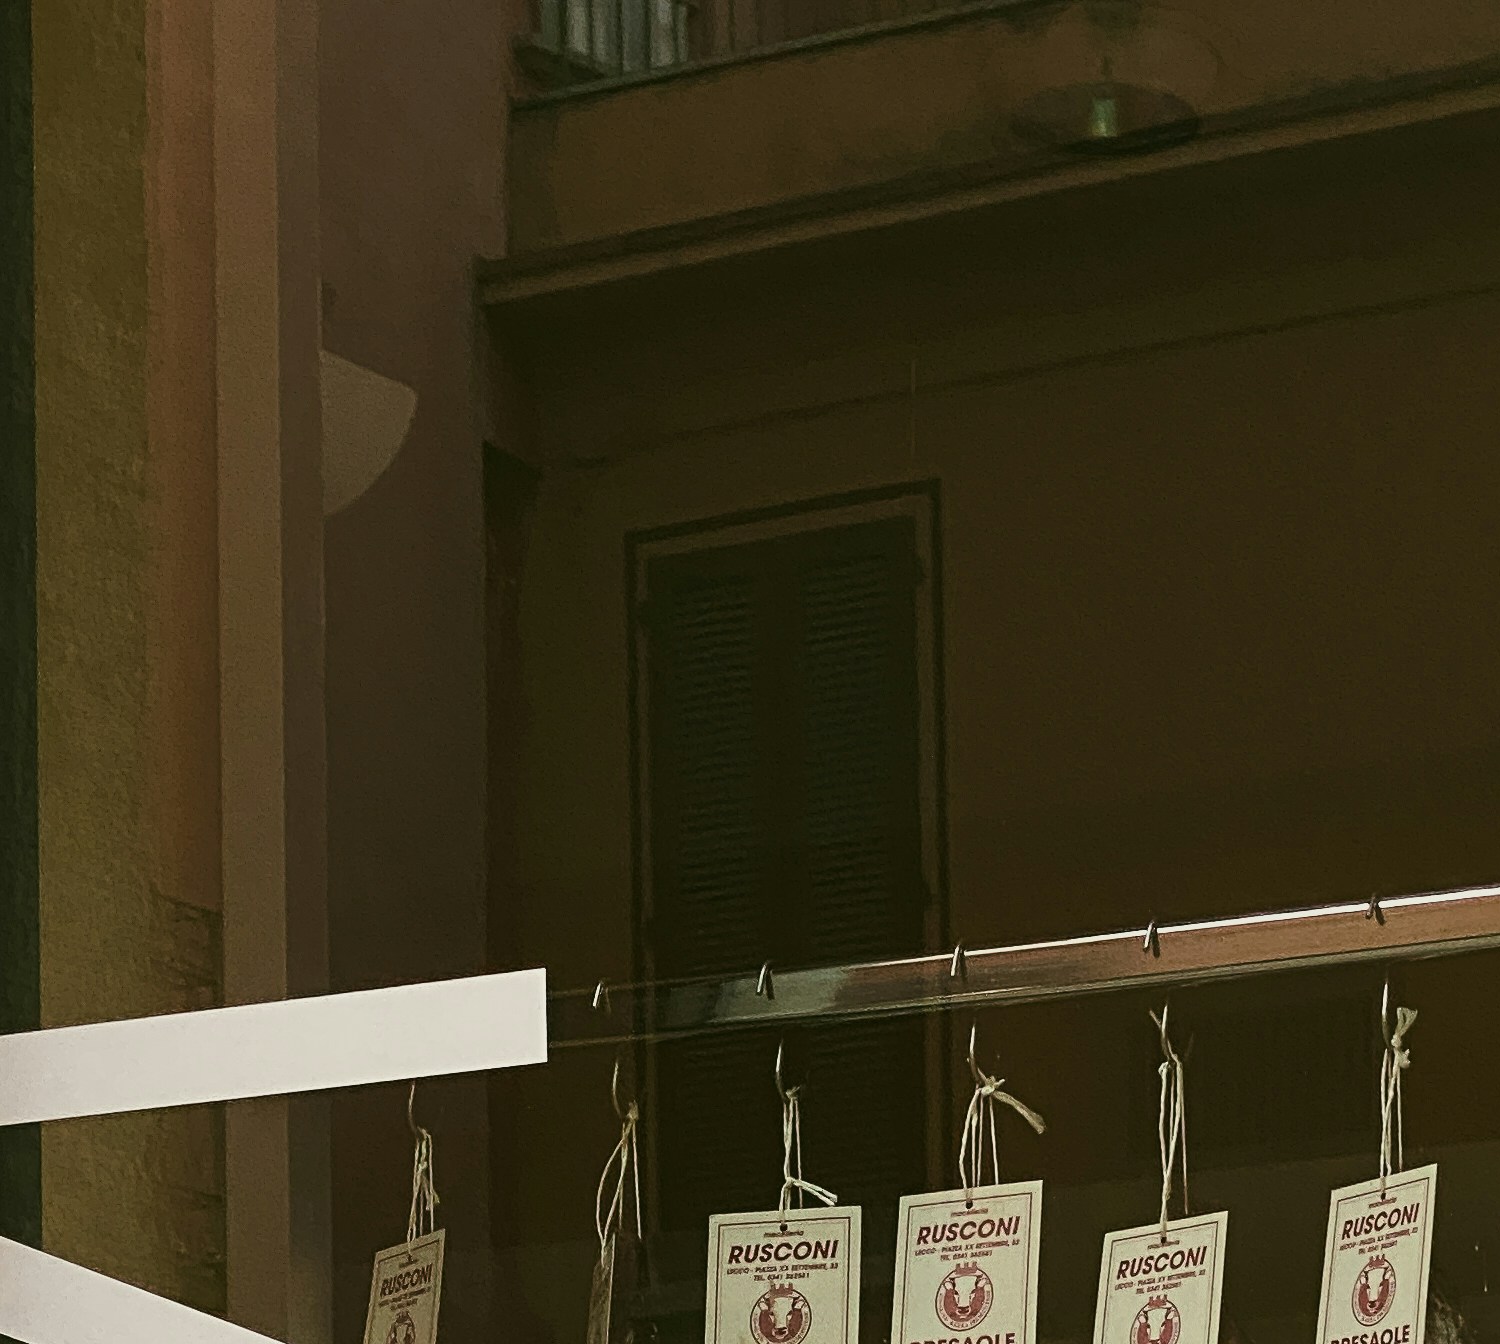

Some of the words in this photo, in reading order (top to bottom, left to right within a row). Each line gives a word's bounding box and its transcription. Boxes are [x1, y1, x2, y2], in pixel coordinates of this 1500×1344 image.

[916, 1215, 1021, 1245] RUSCONI
[1341, 1203, 1420, 1240] RUSCONI
[727, 1239, 839, 1264] RUSCONI
[1116, 1245, 1208, 1280] RUSCONI
[379, 1263, 433, 1298] RUSCONI
